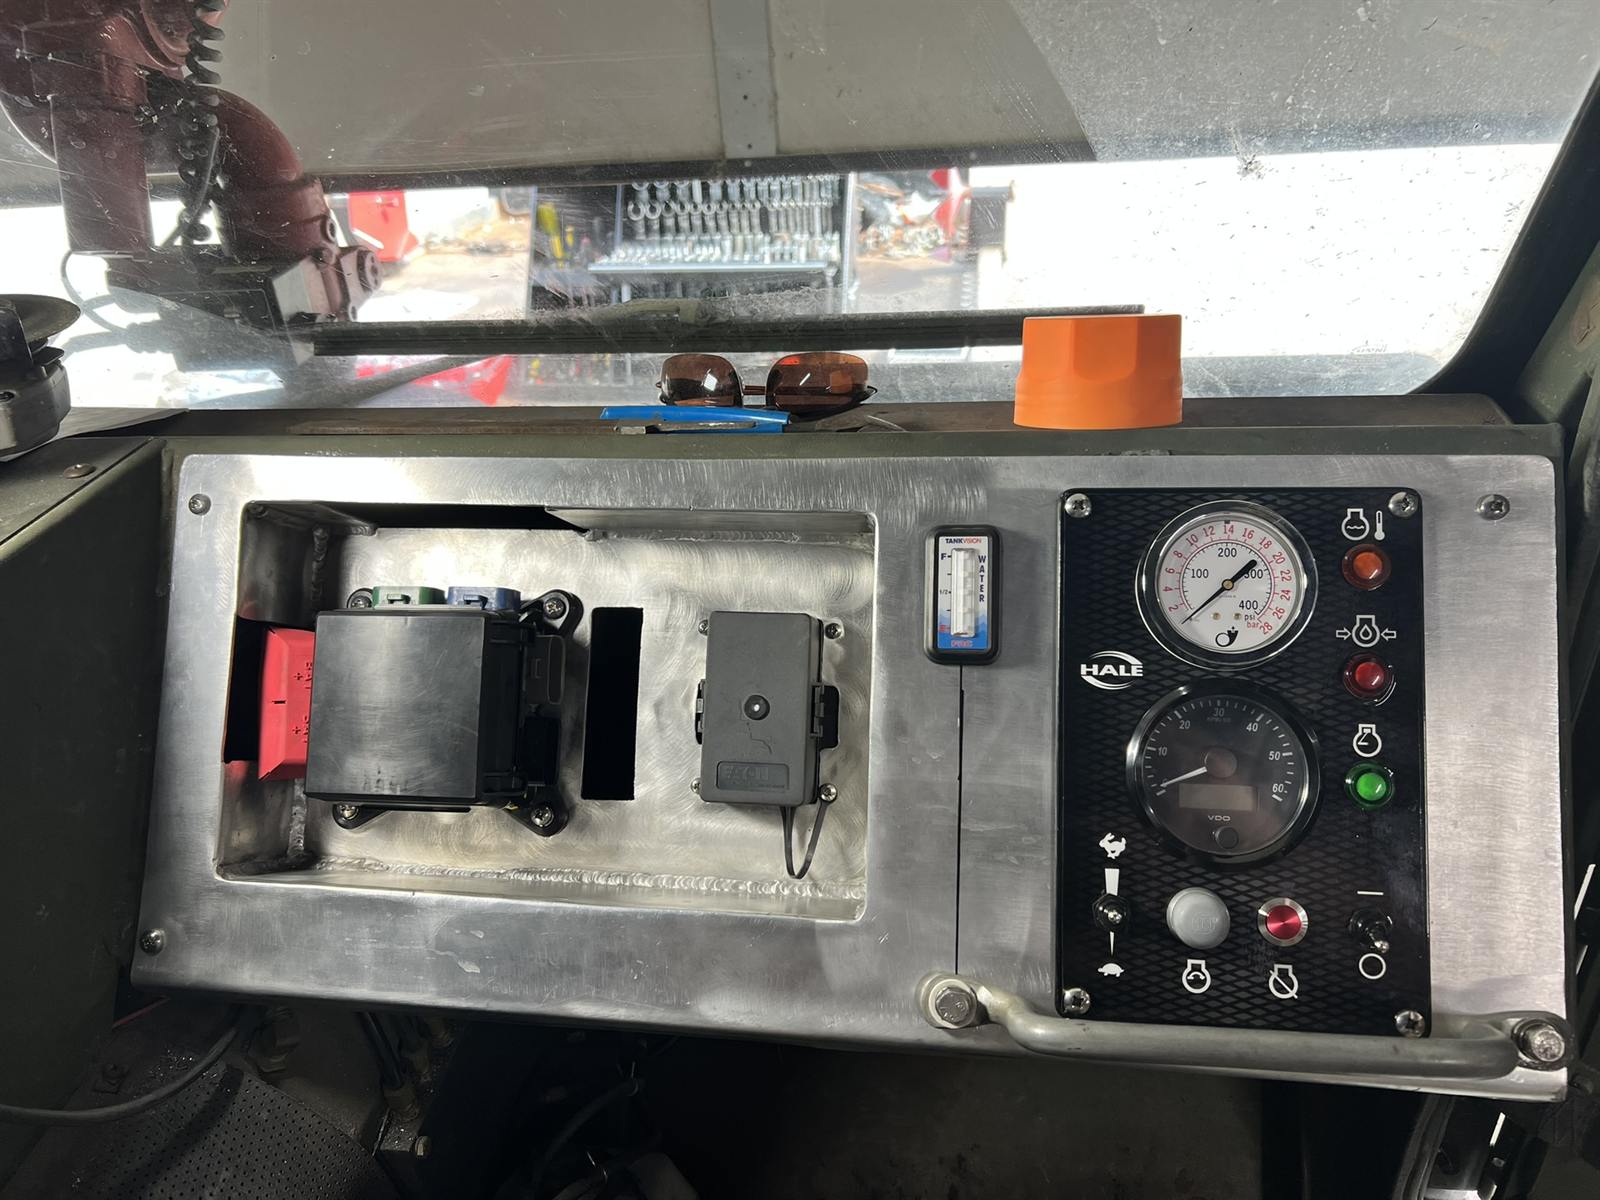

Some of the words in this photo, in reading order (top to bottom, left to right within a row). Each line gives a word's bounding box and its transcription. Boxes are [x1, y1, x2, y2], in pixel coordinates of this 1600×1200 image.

[1203, 526, 1215, 537] 12
[1223, 525, 1234, 534] 14
[1242, 528, 1255, 539] 16
[1186, 534, 1199, 546] 10
[1259, 537, 1272, 549] 18
[1173, 550, 1183, 558] 8
[1218, 548, 1237, 557] 200
[1272, 552, 1285, 564] 20
[978, 555, 986, 602] WATER
[1191, 569, 1208, 578] 100
[1280, 570, 1292, 581] 22
[1280, 590, 1291, 601] 24
[1239, 600, 1258, 610] 400
[1245, 613, 1255, 621] psi
[1273, 608, 1285, 619] 26
[1260, 622, 1272, 634] 28
[1081, 664, 1143, 676] HALE
[1214, 708, 1224, 717] 30
[1179, 720, 1190, 729] 20
[1246, 723, 1258, 732] 40
[1158, 747, 1167, 755] 10
[1268, 751, 1280, 760] 50
[1272, 784, 1284, 793] 60
